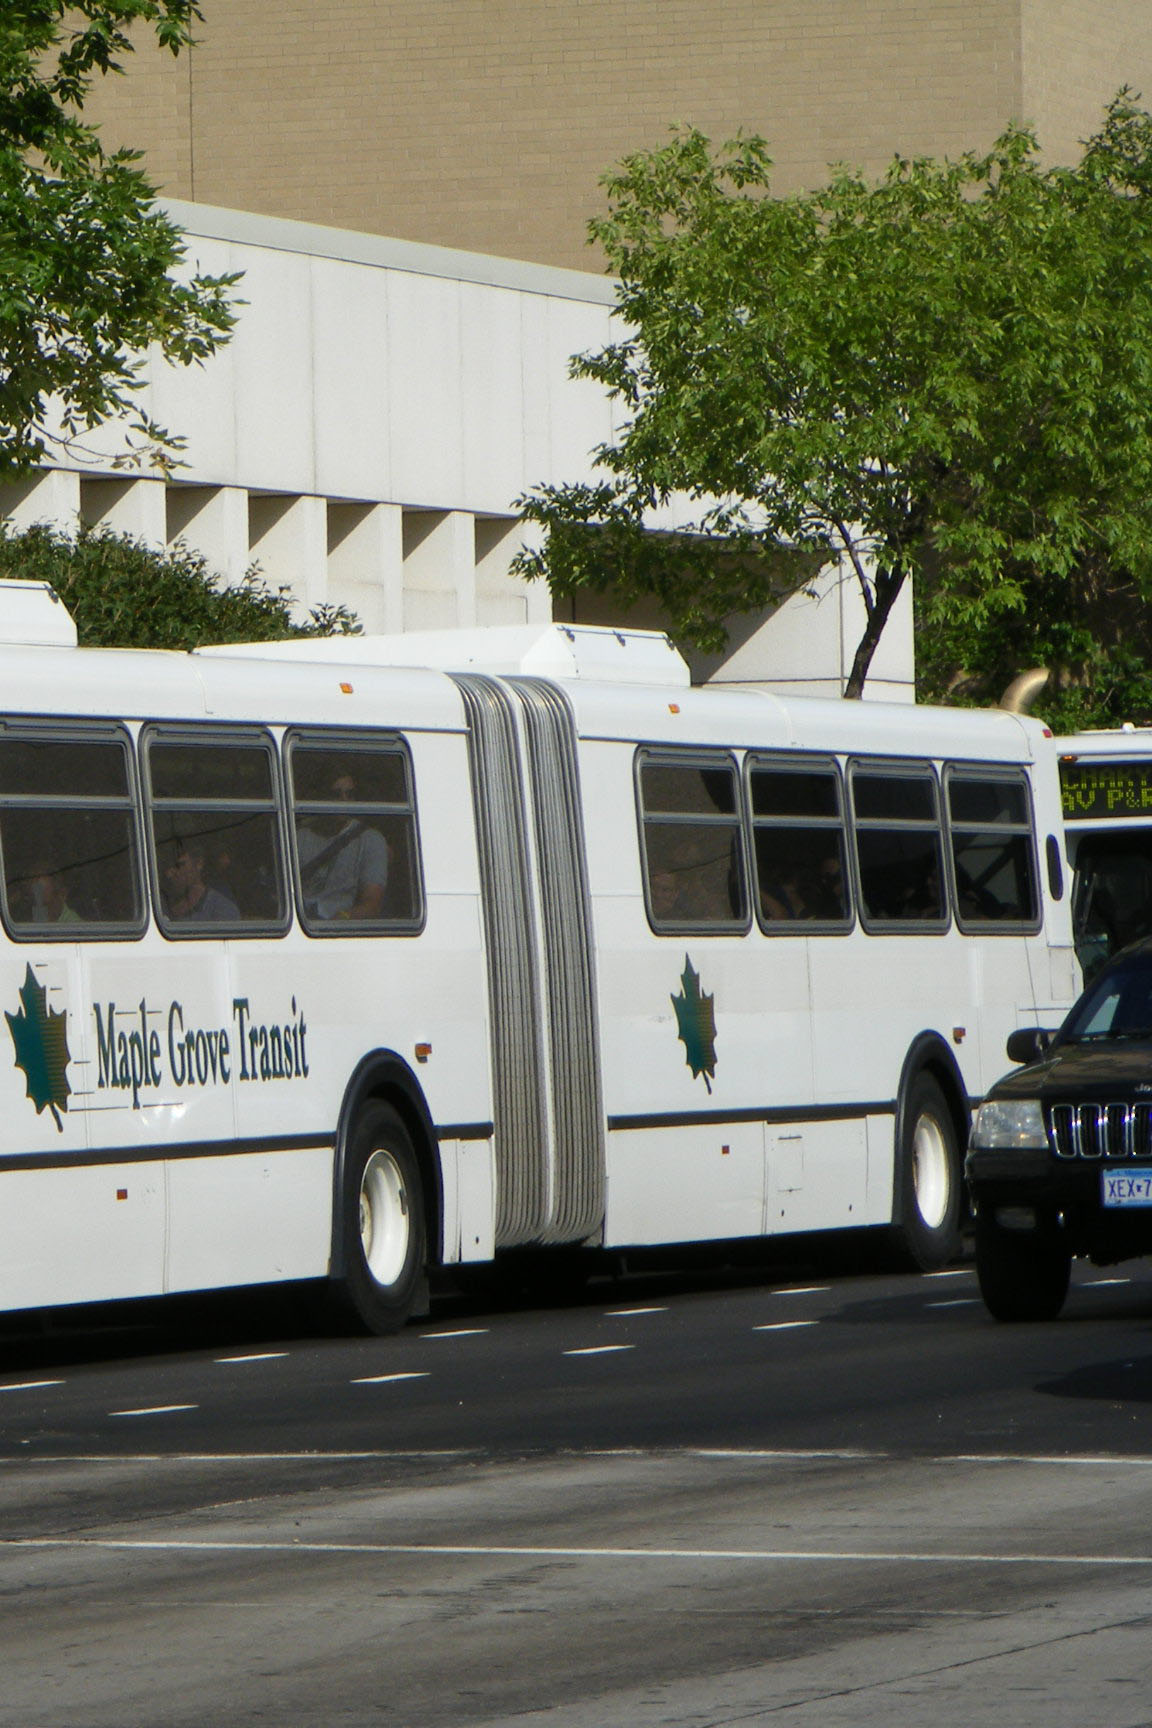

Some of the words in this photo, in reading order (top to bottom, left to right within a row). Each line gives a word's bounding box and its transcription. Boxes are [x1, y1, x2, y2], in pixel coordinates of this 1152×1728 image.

[93, 996, 162, 1110] Maple
[168, 1000, 231, 1088] Grove
[232, 994, 310, 1082] Transit
